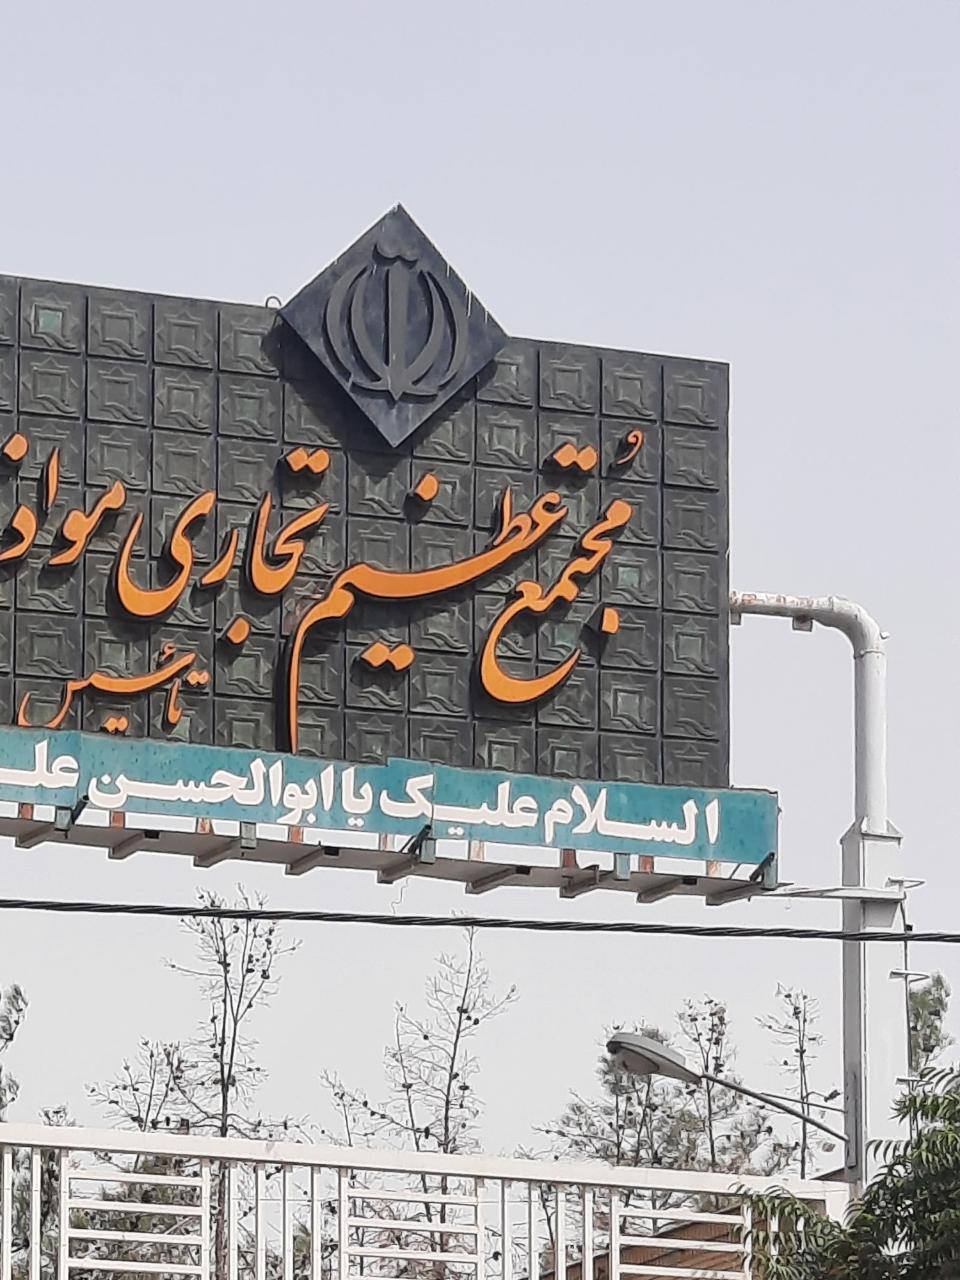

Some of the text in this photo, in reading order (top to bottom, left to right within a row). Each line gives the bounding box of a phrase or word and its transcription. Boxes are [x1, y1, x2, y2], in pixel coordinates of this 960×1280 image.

[3, 457, 125, 566] مواد
[117, 447, 331, 644] تجاری
[85, 758, 336, 826] ابوالحسن
[341, 766, 373, 829] یا
[379, 773, 539, 837] علیک
[544, 784, 720, 847] السلام
